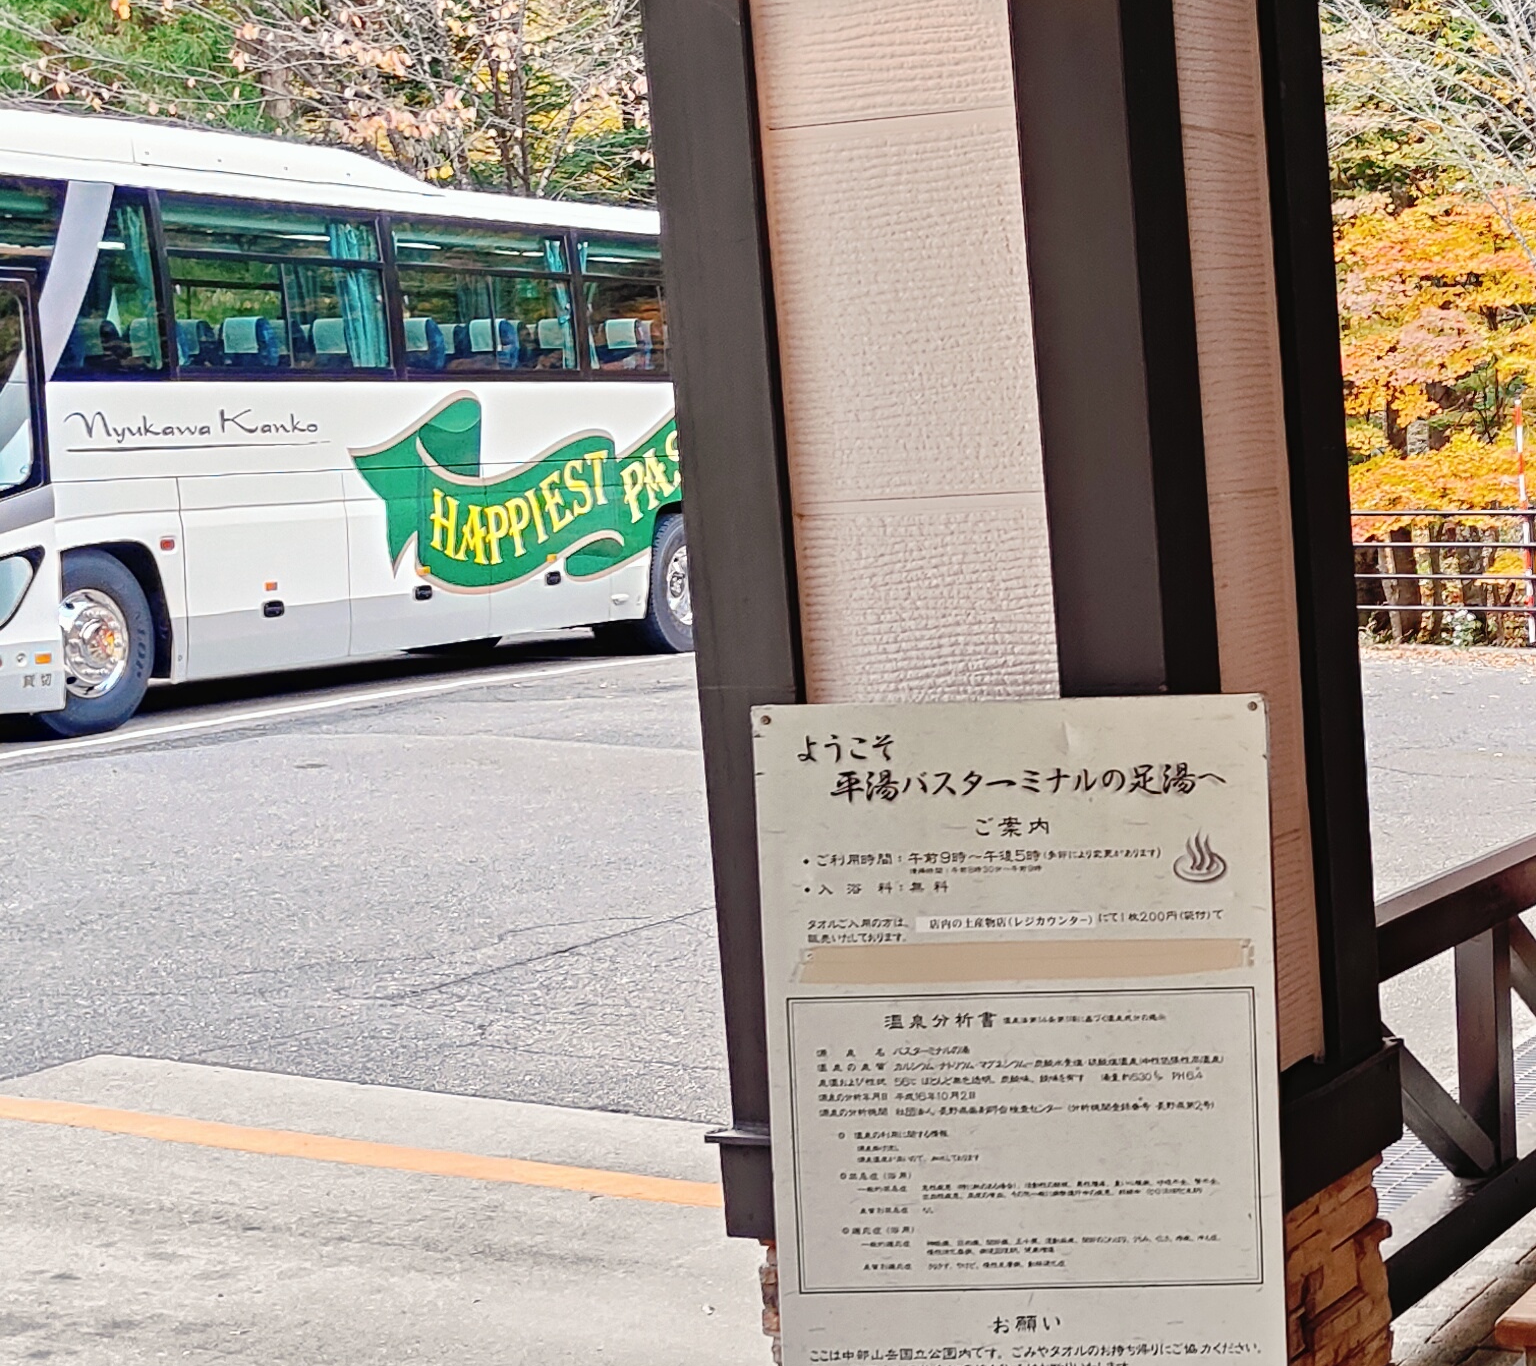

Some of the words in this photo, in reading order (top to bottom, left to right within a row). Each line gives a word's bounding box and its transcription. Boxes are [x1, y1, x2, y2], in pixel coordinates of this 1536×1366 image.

[64, 411, 211, 443] Nyukawa
[219, 409, 318, 434] Kanko
[430, 450, 608, 565] HAPPIEST
[797, 734, 894, 763] ようこそ
[830, 762, 1226, 803] 平湯バスターミナルの足湯へ
[975, 817, 1050, 837] ご案内
[884, 1012, 997, 1029] 温泉分析書
[992, 1315, 1061, 1334] お願い
